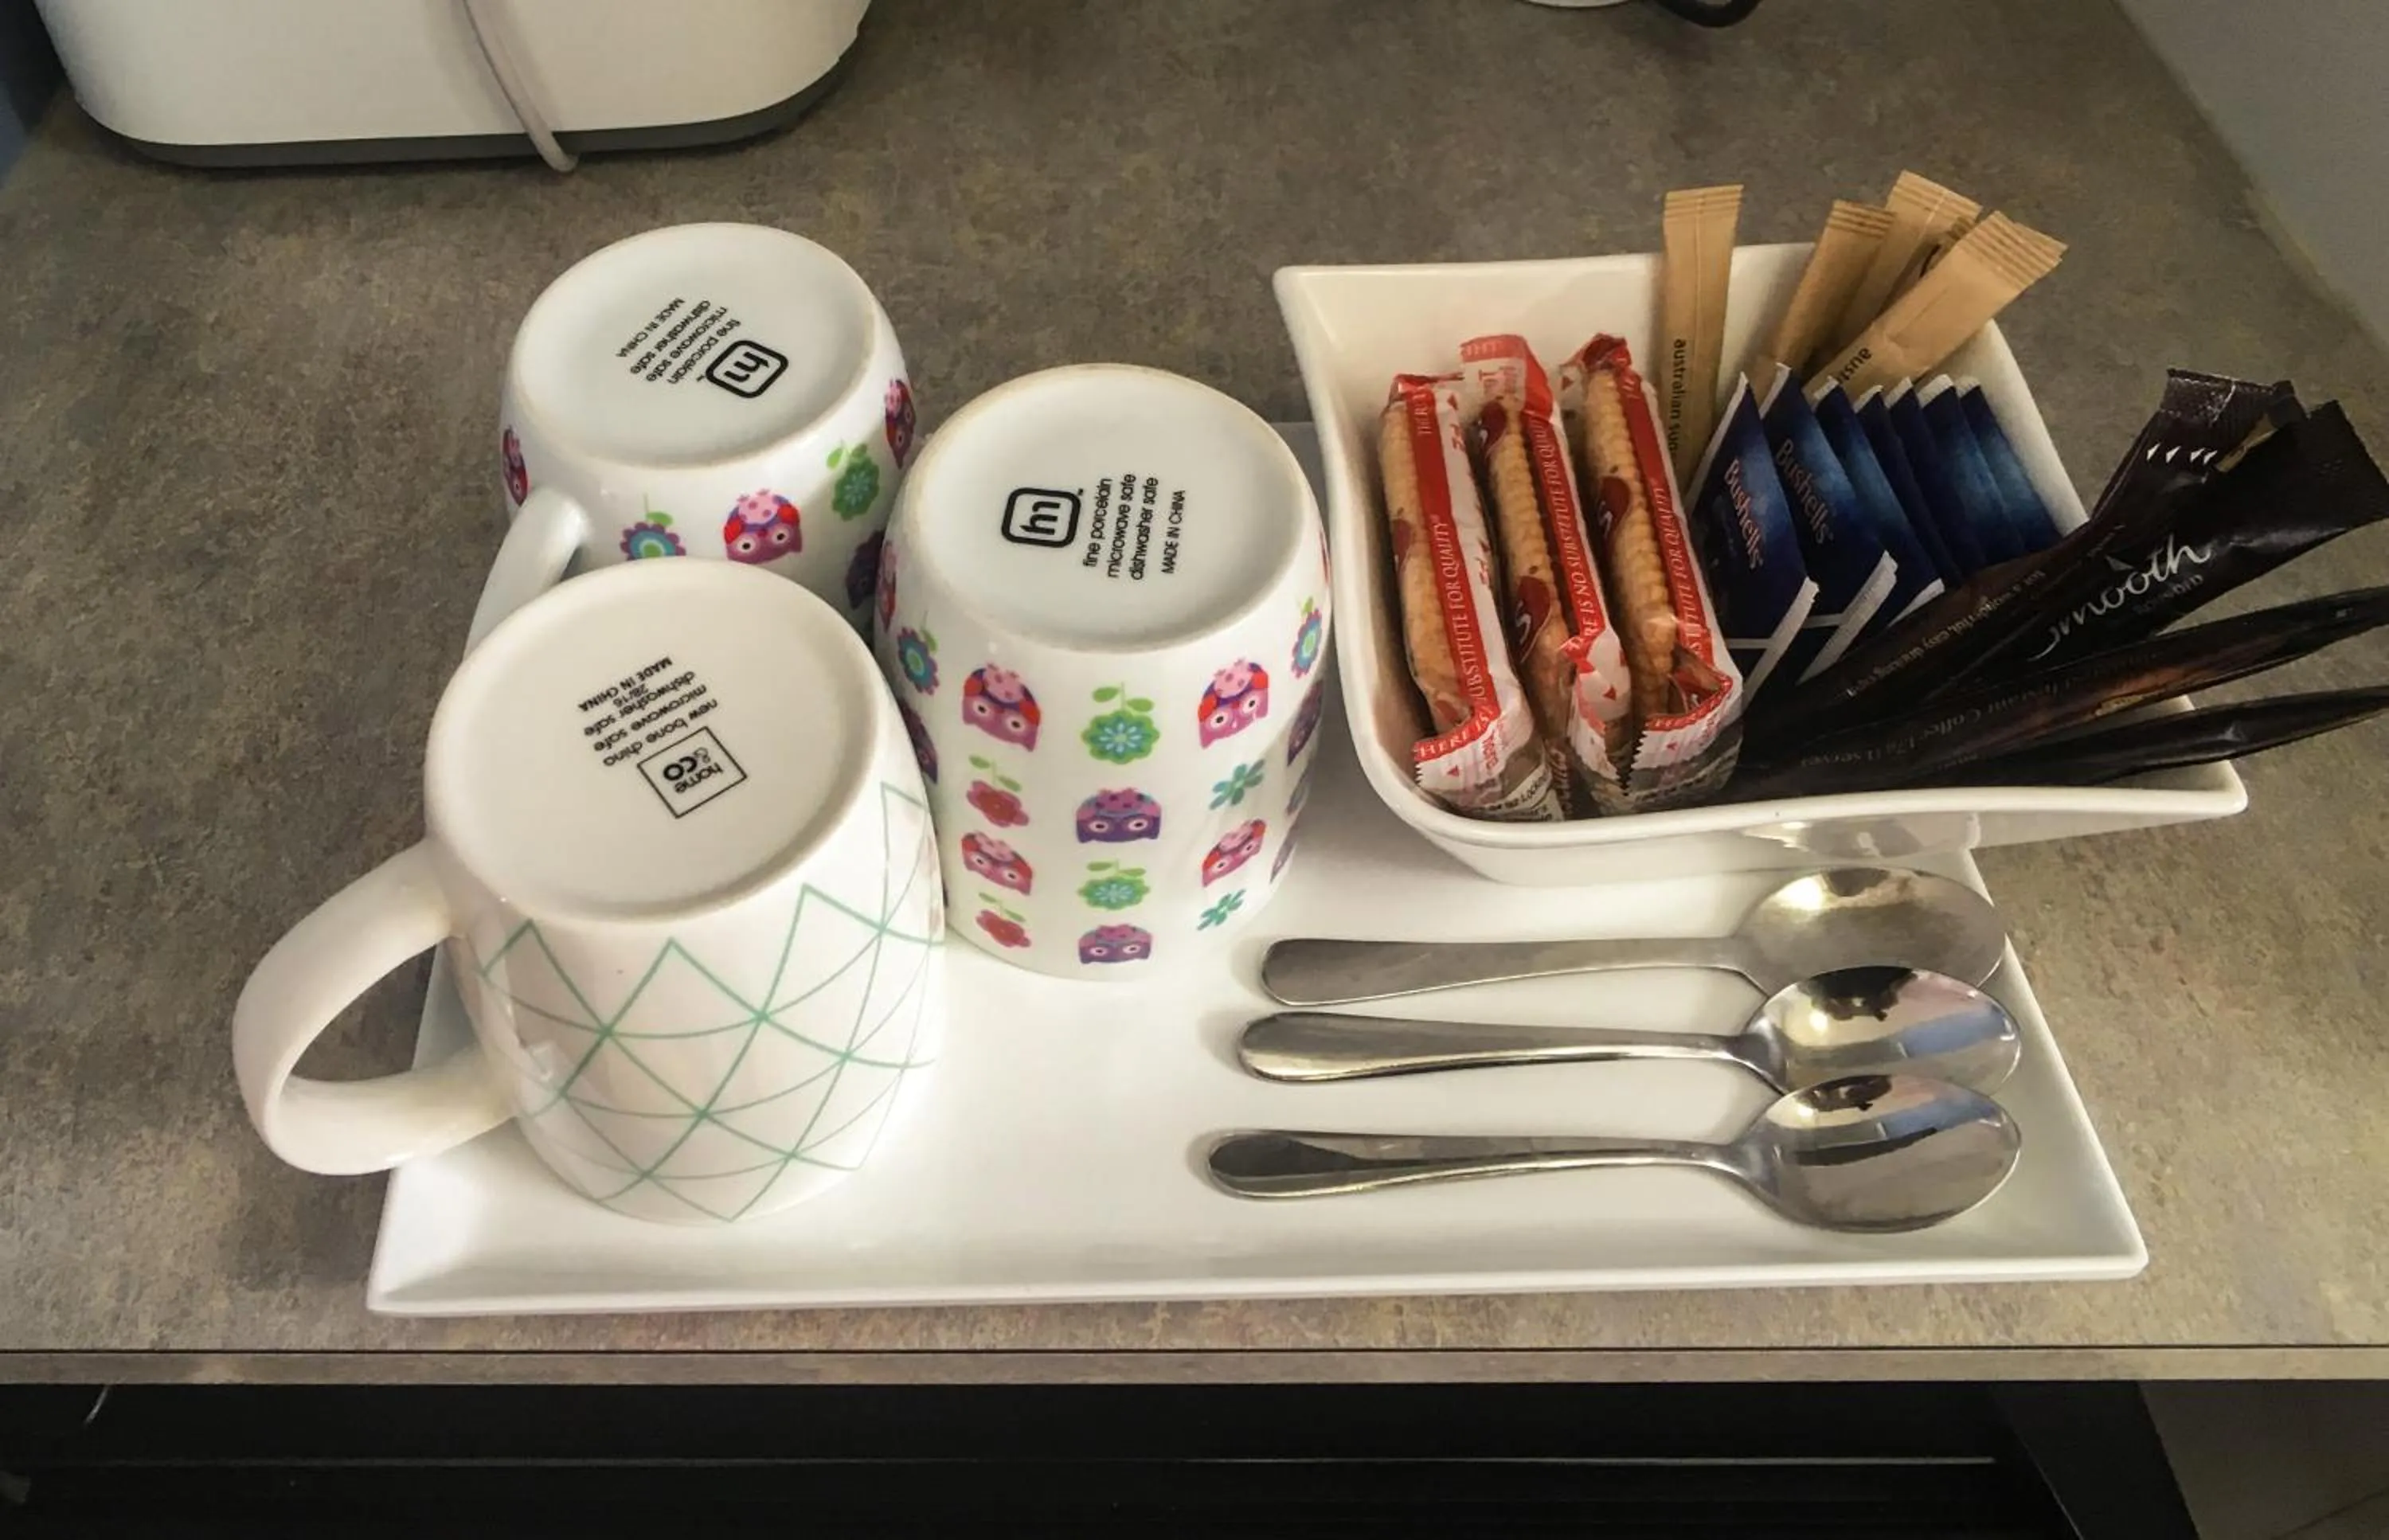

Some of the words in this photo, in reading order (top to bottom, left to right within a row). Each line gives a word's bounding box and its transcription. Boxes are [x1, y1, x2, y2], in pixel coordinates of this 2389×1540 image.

[655, 297, 686, 323] MADE
[644, 321, 659, 332] IN
[655, 299, 711, 352] dishwasher
[669, 306, 729, 359] microwave
[716, 318, 741, 338] fine
[616, 330, 649, 358] CHINA
[630, 351, 656, 374] safe
[645, 358, 673, 382] safe
[667, 335, 719, 385] porcelain
[1671, 338, 1687, 420] australian
[1542, 459, 1562, 487] FOR
[1775, 439, 1830, 544] Bushells
[1089, 477, 1112, 540] porcelain
[1168, 490, 1187, 525] CHINA
[1723, 458, 1761, 569] Bushells
[1106, 504, 1132, 579] microwave
[1120, 473, 1137, 502] safe
[1128, 506, 1154, 580] dishwasher
[1143, 476, 1159, 505] safe
[1167, 526, 1181, 540] IN
[1548, 488, 1582, 568] SUBSTITUTE
[1082, 542, 1101, 567] fine
[1161, 541, 1179, 574] MADE
[1433, 522, 1460, 580] QUALITY
[1447, 582, 1466, 610] FOR
[1570, 572, 1592, 596] NO
[635, 656, 673, 682] MADE
[619, 676, 636, 691] IN
[619, 670, 695, 717] dishwasher
[577, 686, 620, 712] CHINA
[630, 684, 707, 732] microwave
[688, 698, 718, 721] new
[583, 714, 616, 737] safe
[645, 717, 689, 744] bone
[593, 729, 628, 752] safe
[602, 741, 643, 767] china
[674, 762, 724, 794] home
